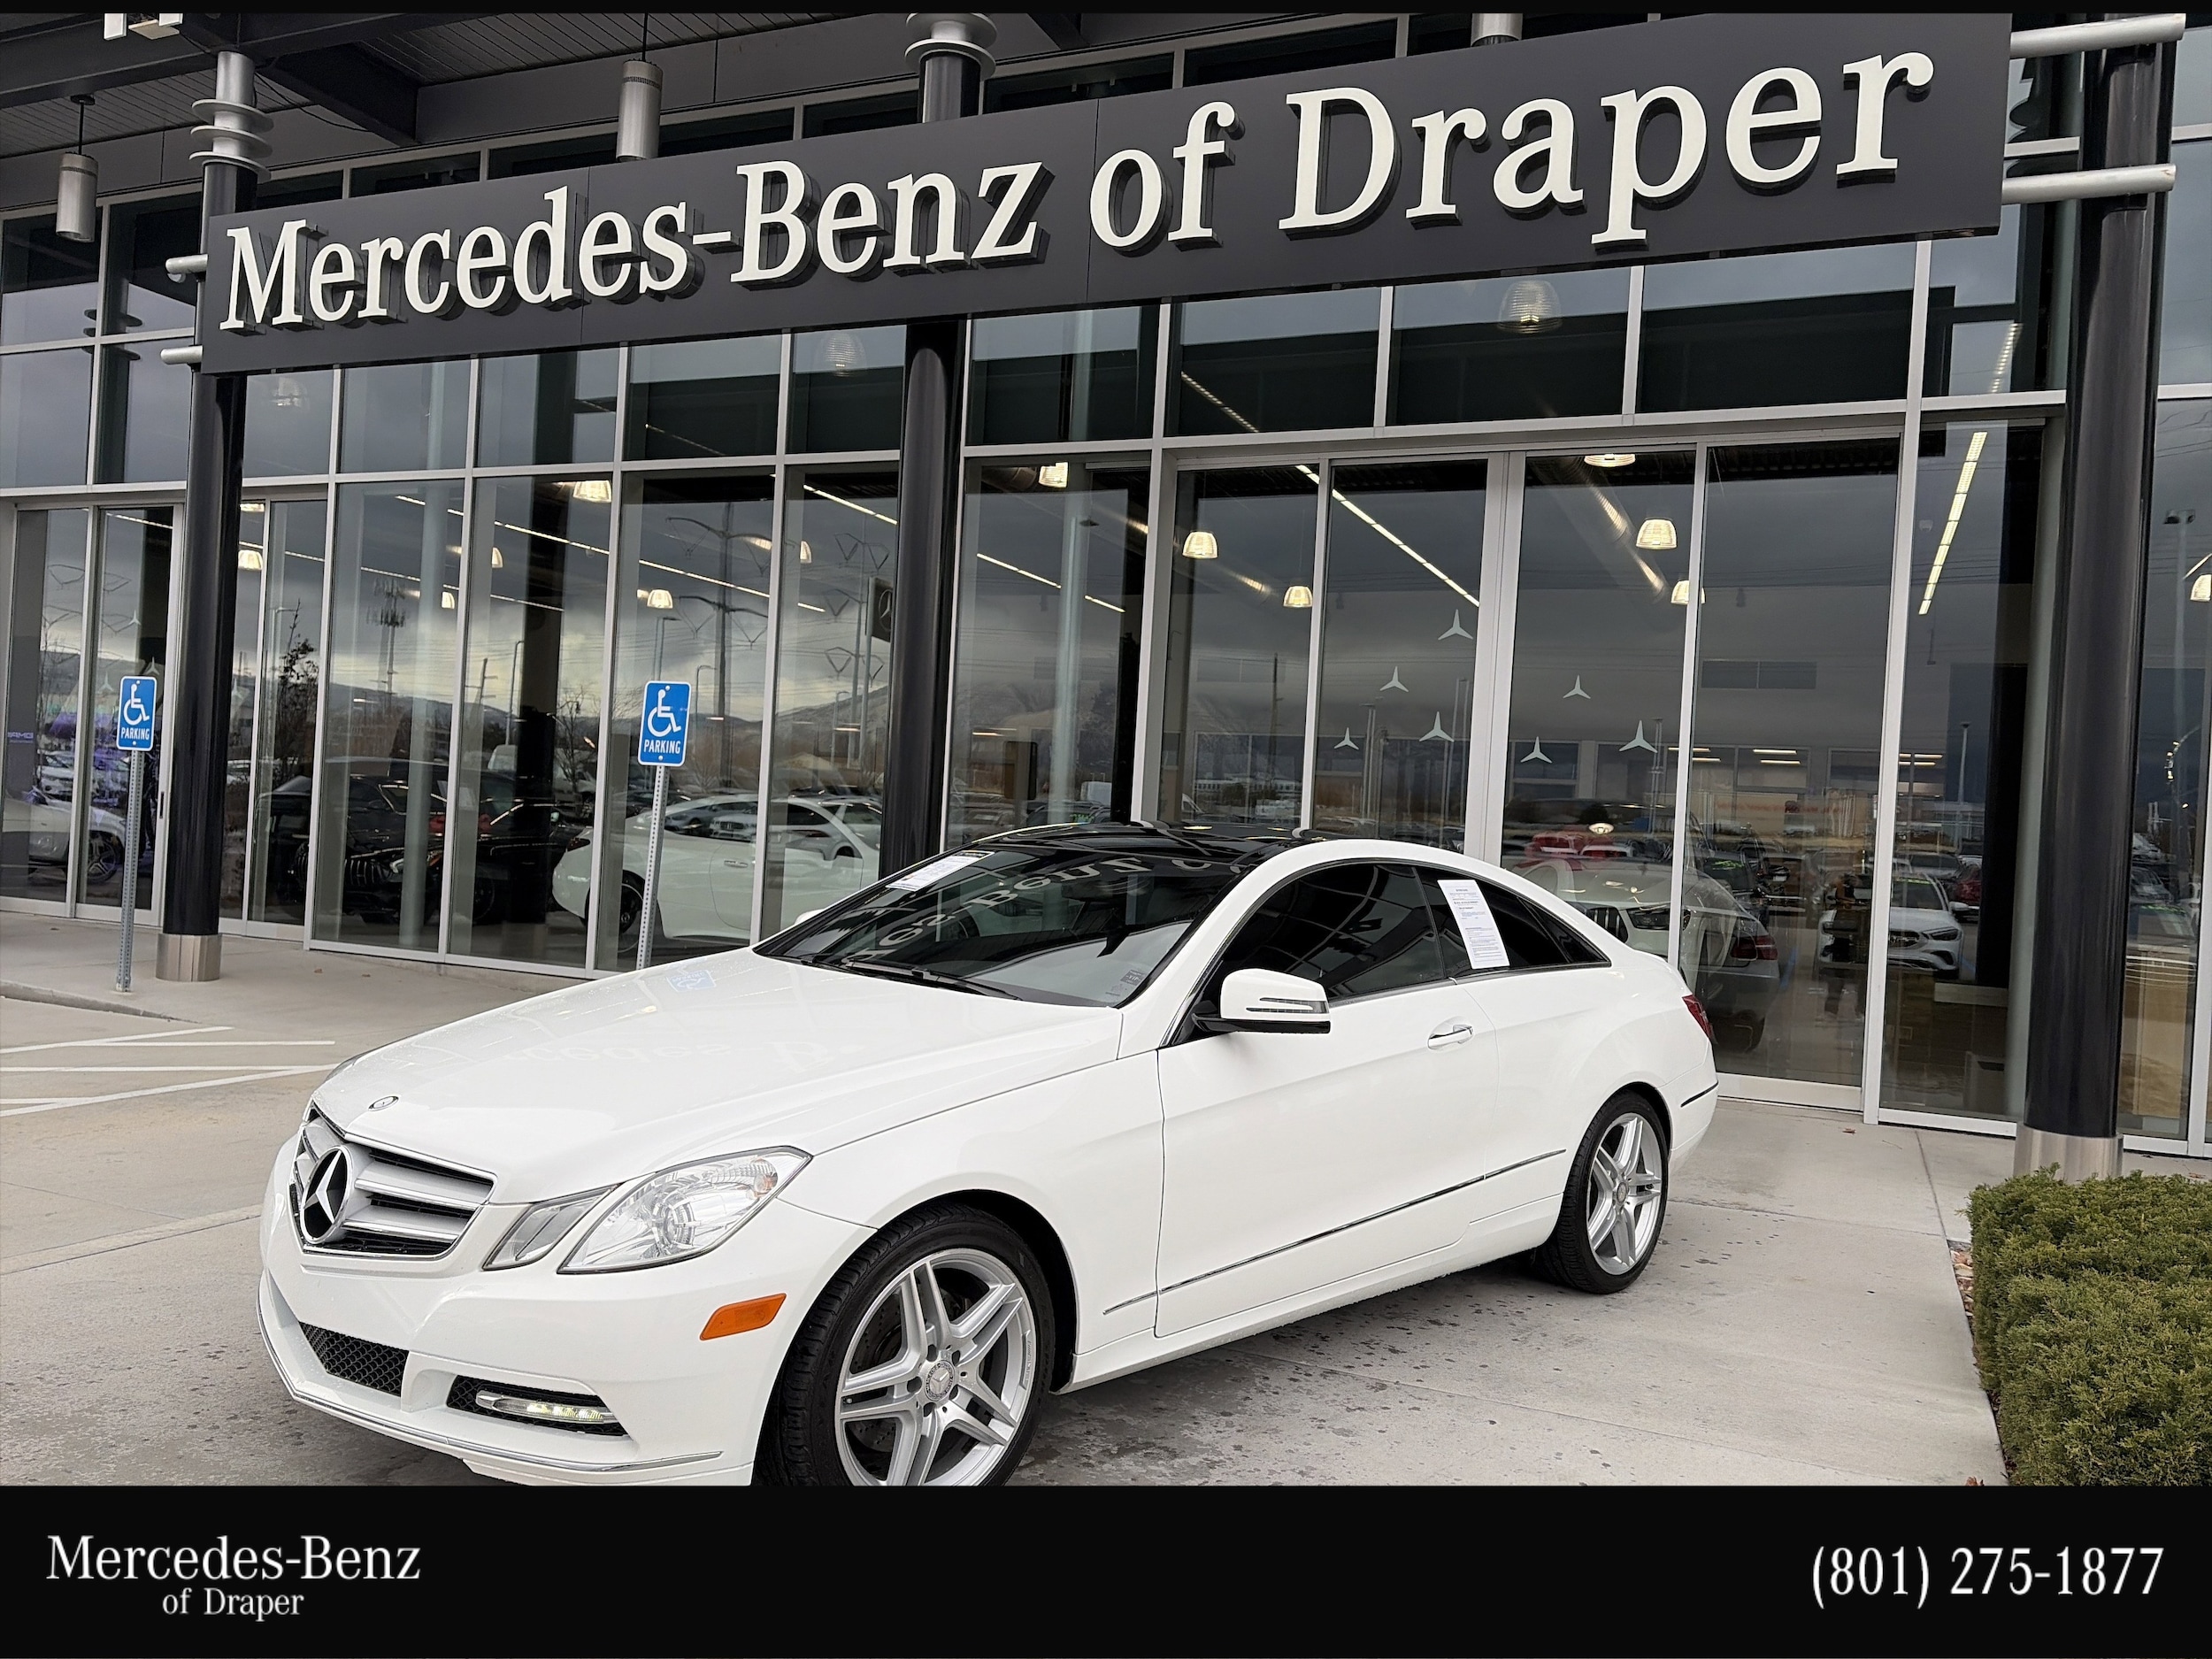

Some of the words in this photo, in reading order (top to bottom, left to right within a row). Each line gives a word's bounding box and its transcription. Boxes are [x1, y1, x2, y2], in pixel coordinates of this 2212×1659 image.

[219, 160, 1044, 330] Mercedes-Benz
[1089, 102, 1236, 248] of
[1278, 51, 1935, 245] Draper
[120, 727, 150, 741] PARKING
[643, 739, 681, 754] PARKING
